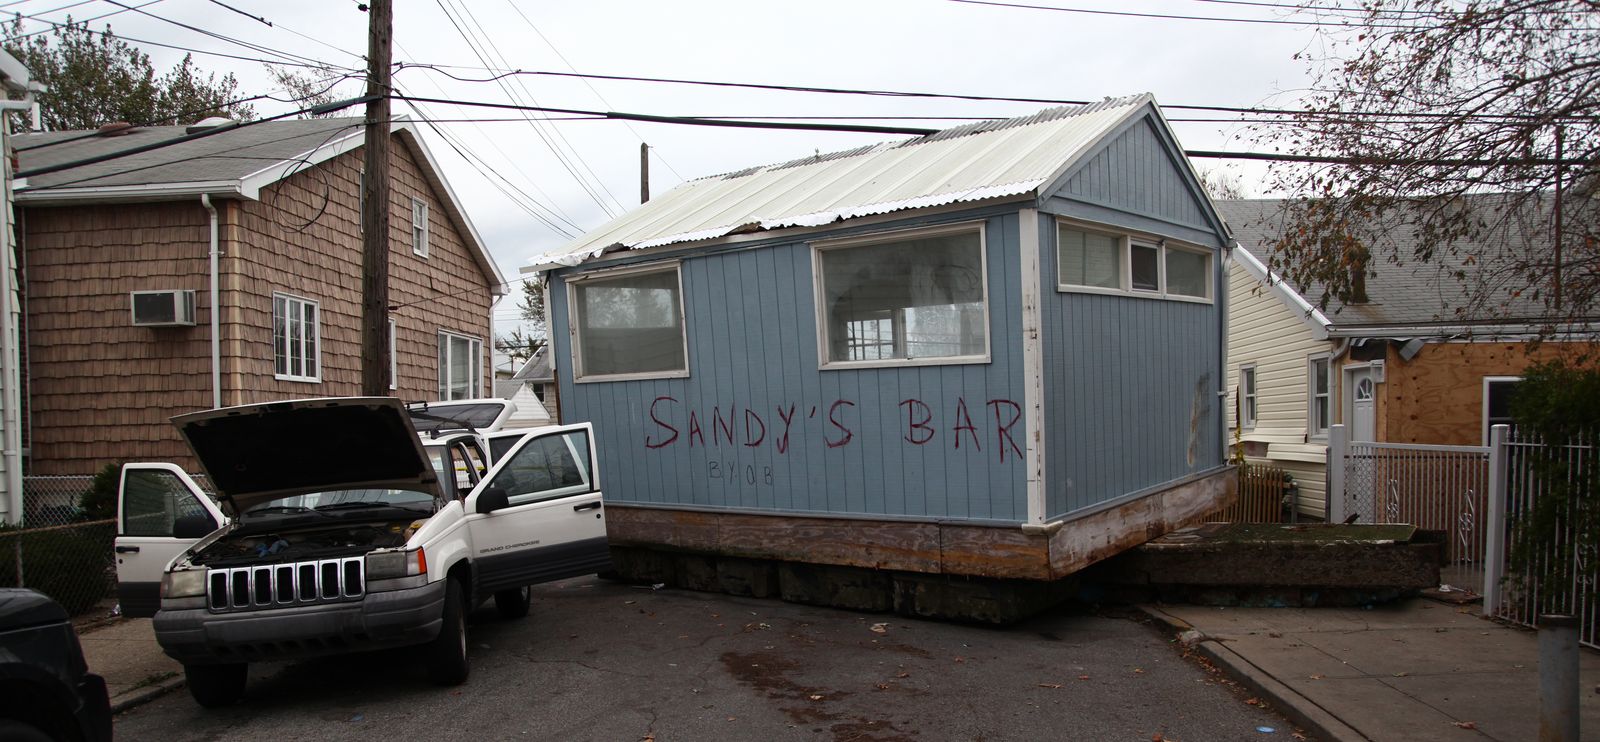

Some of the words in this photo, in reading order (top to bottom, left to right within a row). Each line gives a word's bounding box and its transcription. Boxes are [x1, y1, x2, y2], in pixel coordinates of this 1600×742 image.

[646, 396, 855, 454] SANDY'S
[899, 397, 1024, 463] BAR
[480, 545, 504, 554] GRAND
[505, 539, 540, 550] CHEROKEE
